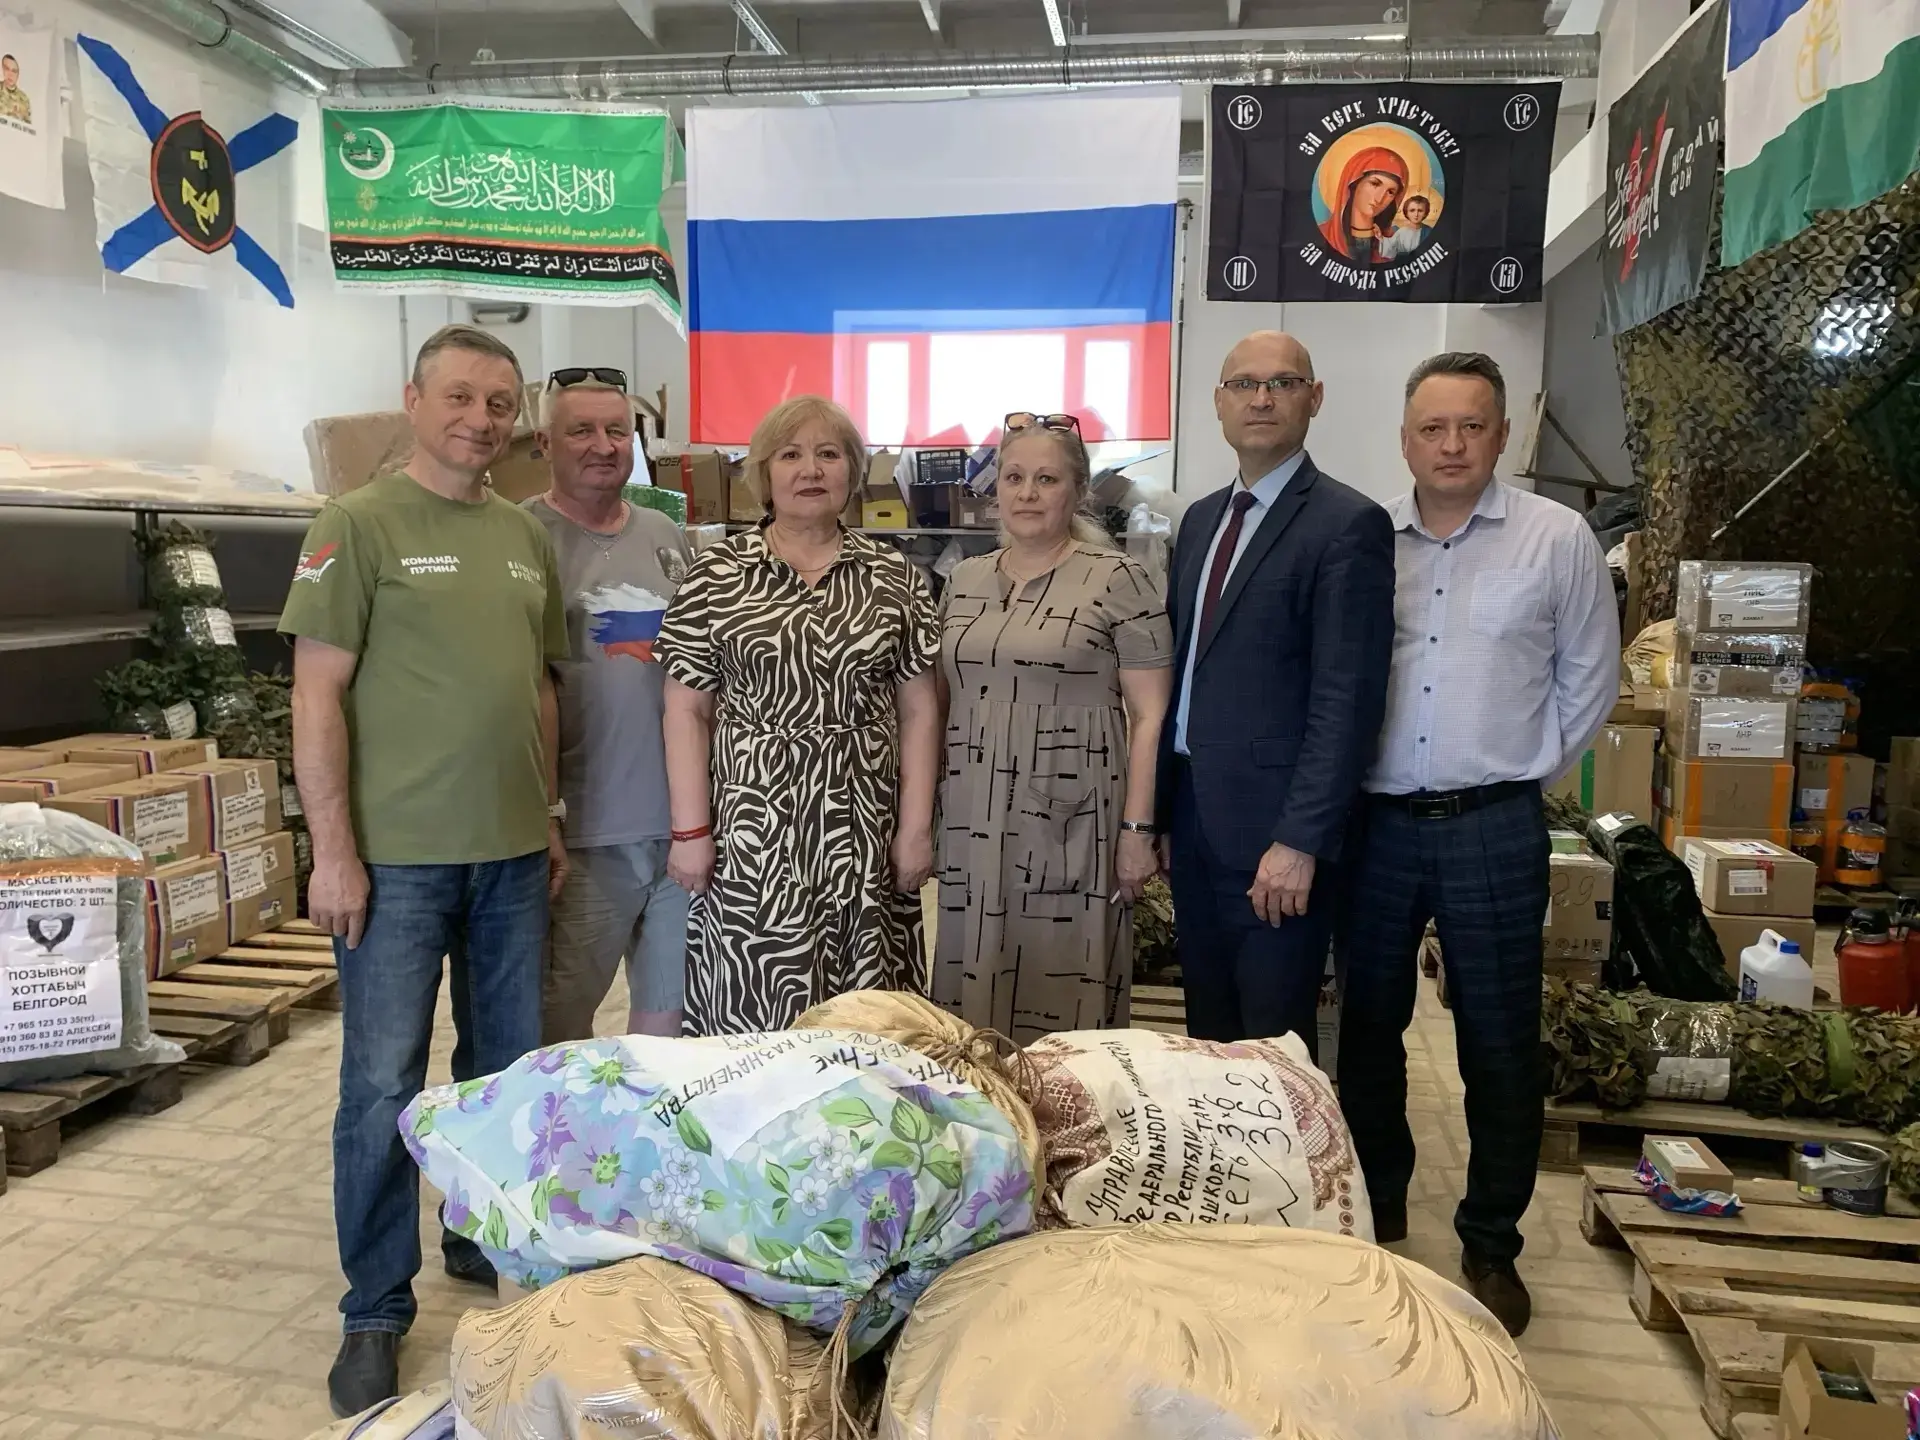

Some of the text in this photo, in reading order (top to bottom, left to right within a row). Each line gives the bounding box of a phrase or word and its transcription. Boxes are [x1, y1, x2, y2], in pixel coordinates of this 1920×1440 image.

[400, 555, 460, 567] КОМАНДА
[410, 564, 459, 575] ПУТИНА
[8, 875, 72, 887] МАСКСЕТИ
[64, 887, 114, 895] КАМУФЛЯЖ
[80, 898, 86, 907] 2
[8, 965, 87, 982] ПОЗЫВНОЙ
[11, 981, 87, 996] ХОТТАБЫЧ
[13, 994, 88, 1011] БЕЛГОРОД
[4, 1023, 15, 1031] +7
[18, 1020, 35, 1030] 965
[39, 1019, 54, 1028] 123
[20, 1032, 37, 1042] 360
[39, 1030, 50, 1039] 83
[53, 1029, 64, 1037] 82
[66, 1022, 112, 1037] АЛЕКСЕЙ
[66, 1032, 117, 1047] ГРИГОРИЙ
